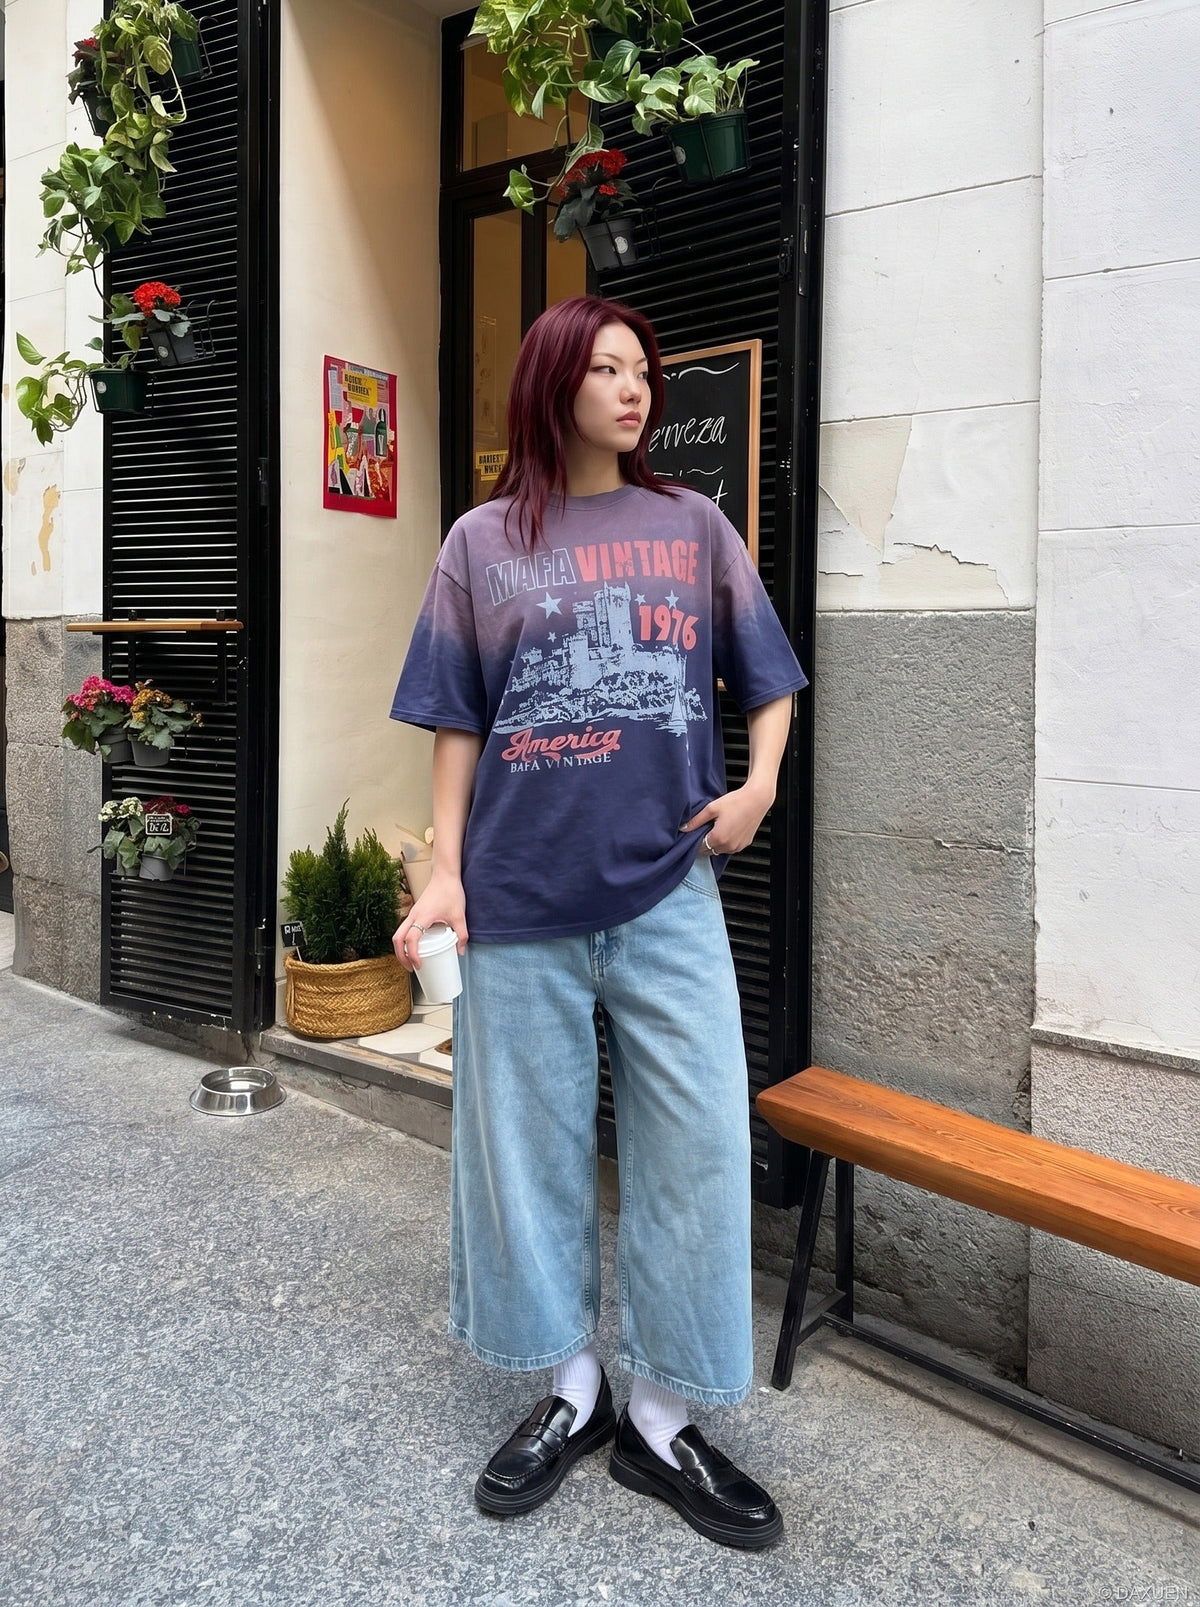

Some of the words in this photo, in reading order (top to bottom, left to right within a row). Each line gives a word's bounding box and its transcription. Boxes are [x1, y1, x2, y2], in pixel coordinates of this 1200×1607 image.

[648, 415, 728, 453] erveza
[485, 547, 577, 607] MAFA
[574, 538, 699, 585] VINTAGE
[638, 604, 699, 651] 1976
[501, 725, 622, 763] America
[510, 759, 541, 773] BAFA
